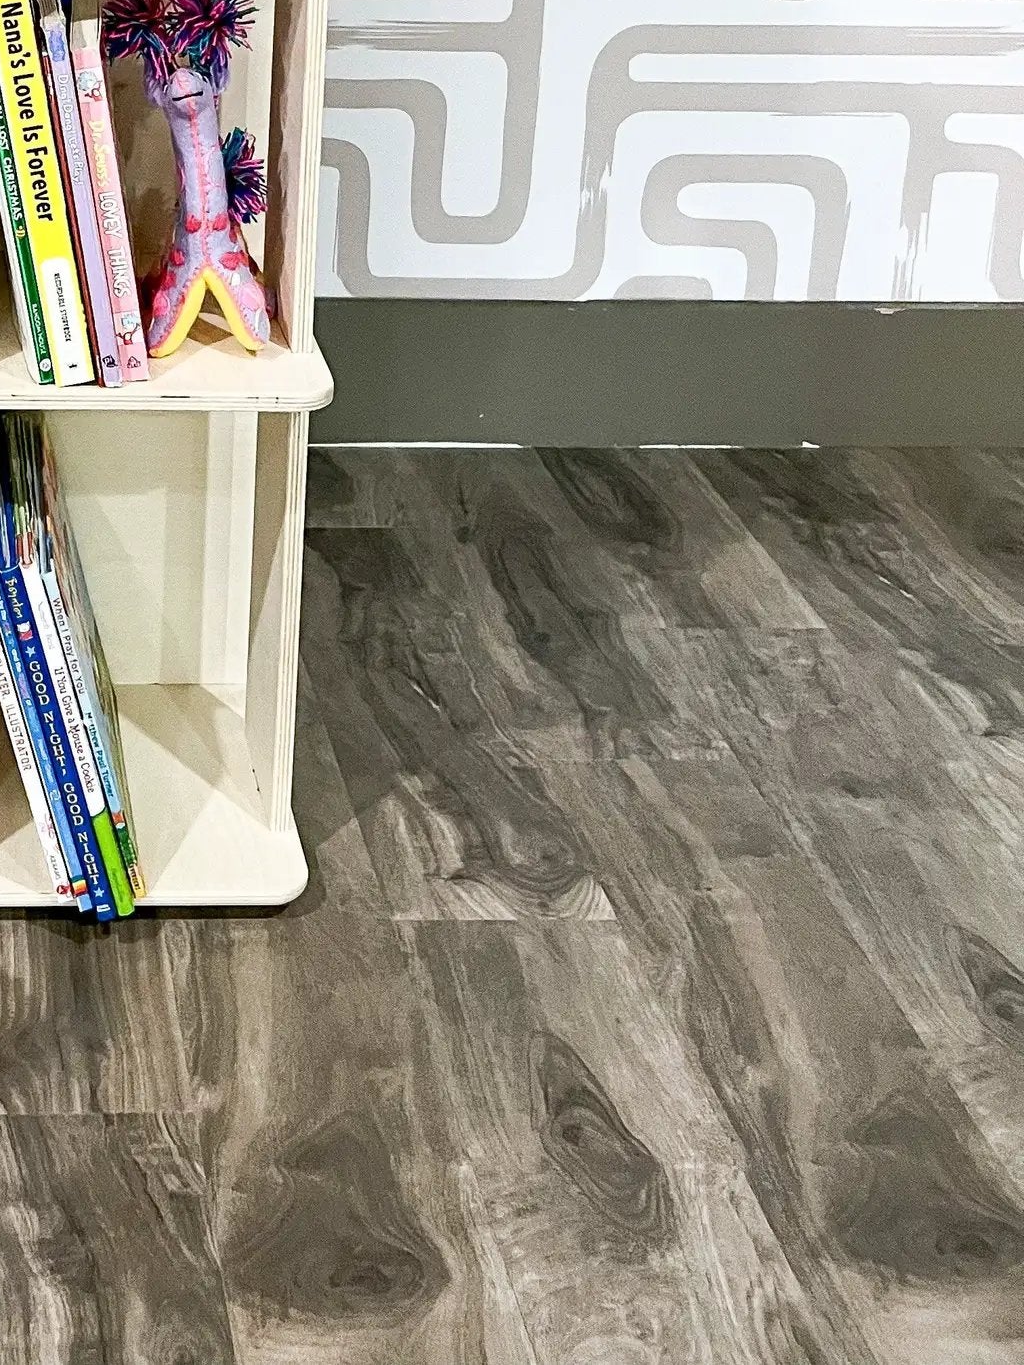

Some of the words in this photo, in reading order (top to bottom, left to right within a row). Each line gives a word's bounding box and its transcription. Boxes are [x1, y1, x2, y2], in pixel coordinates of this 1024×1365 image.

[1, 2, 28, 69] Nana's
[12, 73, 38, 120] Love
[21, 125, 44, 143] Is
[2, 157, 24, 221] CHRISTMAS
[26, 147, 54, 223] Forever
[70, 161, 86, 186] Play!
[98, 189, 123, 239] LOVEY
[107, 247, 132, 298] THINGS
[51, 598, 65, 629] When
[60, 635, 74, 657] Pray
[54, 667, 64, 677] If
[69, 659, 80, 674] for
[56, 676, 68, 695] You
[74, 677, 85, 696] You
[61, 695, 74, 716] Give
[4, 703, 34, 771] ILLUSTRATOR
[67, 724, 83, 755] Mouse
[84, 711, 98, 747] Mtthew
[95, 750, 107, 769] Paul
[101, 770, 113, 798] Turner
[28, 659, 50, 707] GOOD
[62, 781, 85, 827] GOOD
[76, 831, 101, 886] NIGHT
[80, 762, 94, 794] Cookie
